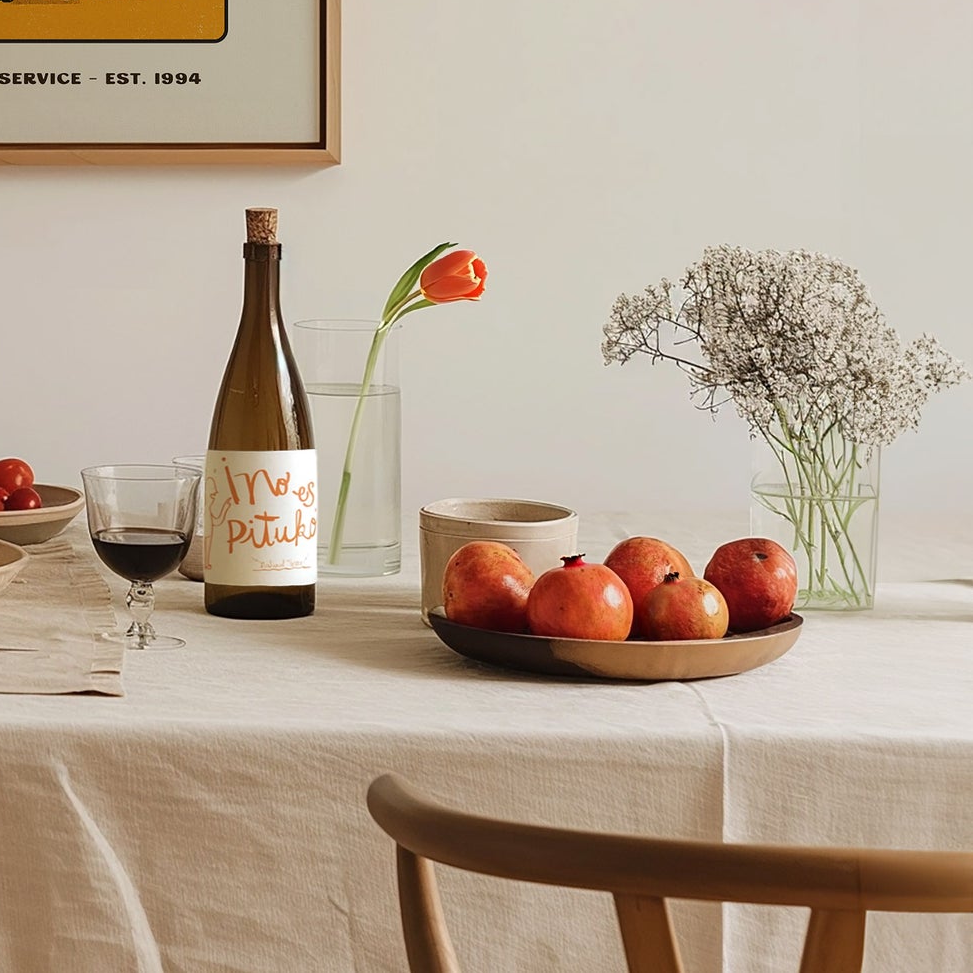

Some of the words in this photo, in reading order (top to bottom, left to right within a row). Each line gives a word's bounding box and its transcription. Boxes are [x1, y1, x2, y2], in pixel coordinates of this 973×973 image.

[105, 72, 146, 85] EST.
[154, 72, 202, 85] 1994
[292, 481, 315, 507] es
